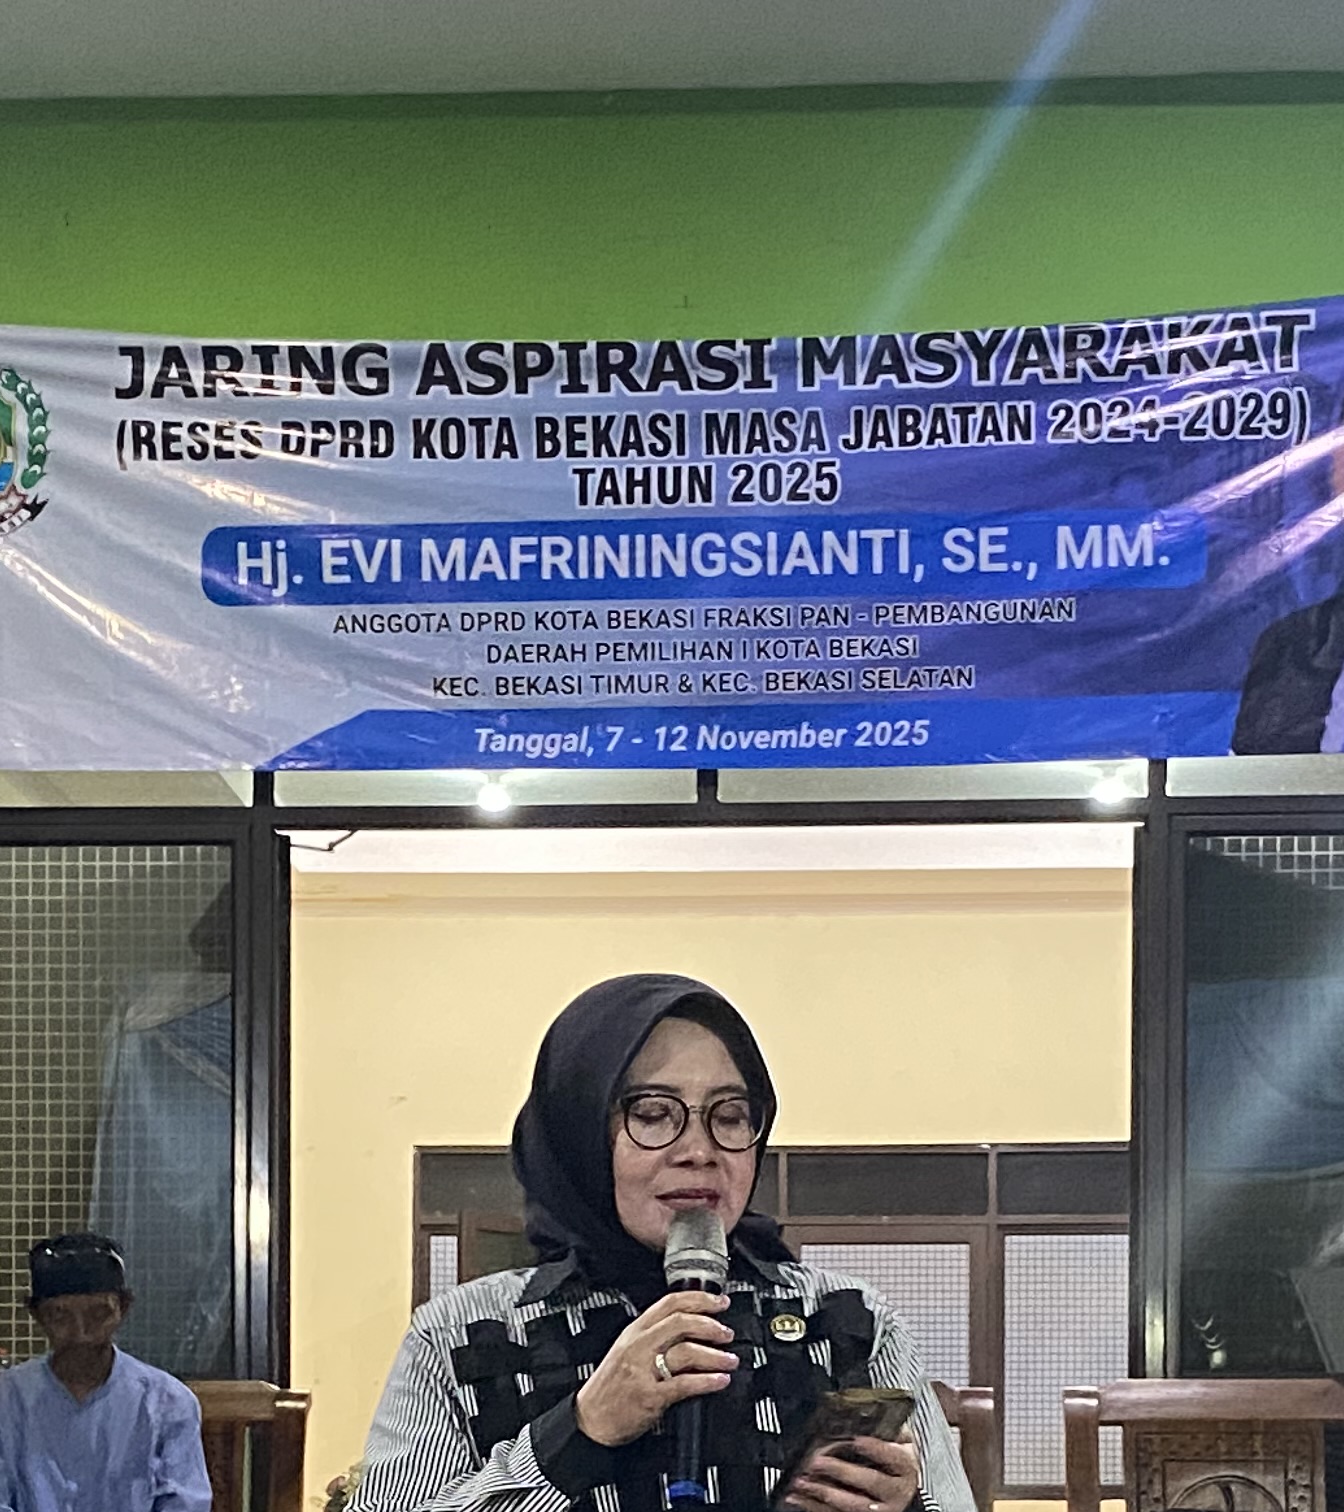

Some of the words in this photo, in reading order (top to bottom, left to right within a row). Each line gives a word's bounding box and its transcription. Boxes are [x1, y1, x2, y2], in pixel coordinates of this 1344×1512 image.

[115, 343, 390, 399] JARING
[416, 338, 774, 396] ASPIRASI
[801, 313, 1311, 388] MASYARAKAT
[116, 419, 263, 471] (RESES
[280, 420, 395, 459] DPRD
[412, 416, 519, 460] KOTA
[535, 412, 687, 459] BEKASI
[705, 410, 827, 455] MASA
[842, 403, 1032, 450] JABATAN
[1051, 389, 1309, 446] 2024-2029)
[572, 465, 713, 505] TAHUN
[730, 460, 839, 502] 2025
[236, 539, 303, 597] Hj.
[321, 538, 403, 584] EVI
[420, 529, 924, 583] MAFRININGSIANTI,
[942, 526, 1038, 582] SE.,
[1056, 523, 1170, 570] MM.
[333, 612, 452, 634] ANGGOTA
[460, 611, 525, 632] DPRD
[535, 610, 599, 631] KOTA
[607, 608, 695, 630] BEKASI
[704, 606, 792, 628] FRAKSI
[800, 605, 850, 627] PAN
[874, 600, 1074, 625] PEMBANGUNAN
[486, 642, 588, 664] DAERAH
[595, 640, 733, 662] PEMILIHAN
[756, 639, 821, 660] KOTA
[829, 637, 918, 658] BEKASI
[432, 676, 487, 698] KEC.
[496, 675, 584, 696] BEKASI
[590, 673, 669, 694] TIMUR
[678, 674, 693, 693] &
[702, 672, 756, 693] KEC.
[765, 670, 853, 692] BEKASI
[861, 667, 973, 689] SELATAN
[474, 725, 595, 758] Tanggal,
[605, 726, 624, 752] 7
[654, 725, 689, 752] 12
[696, 722, 848, 751] November
[854, 719, 931, 748] 2025
